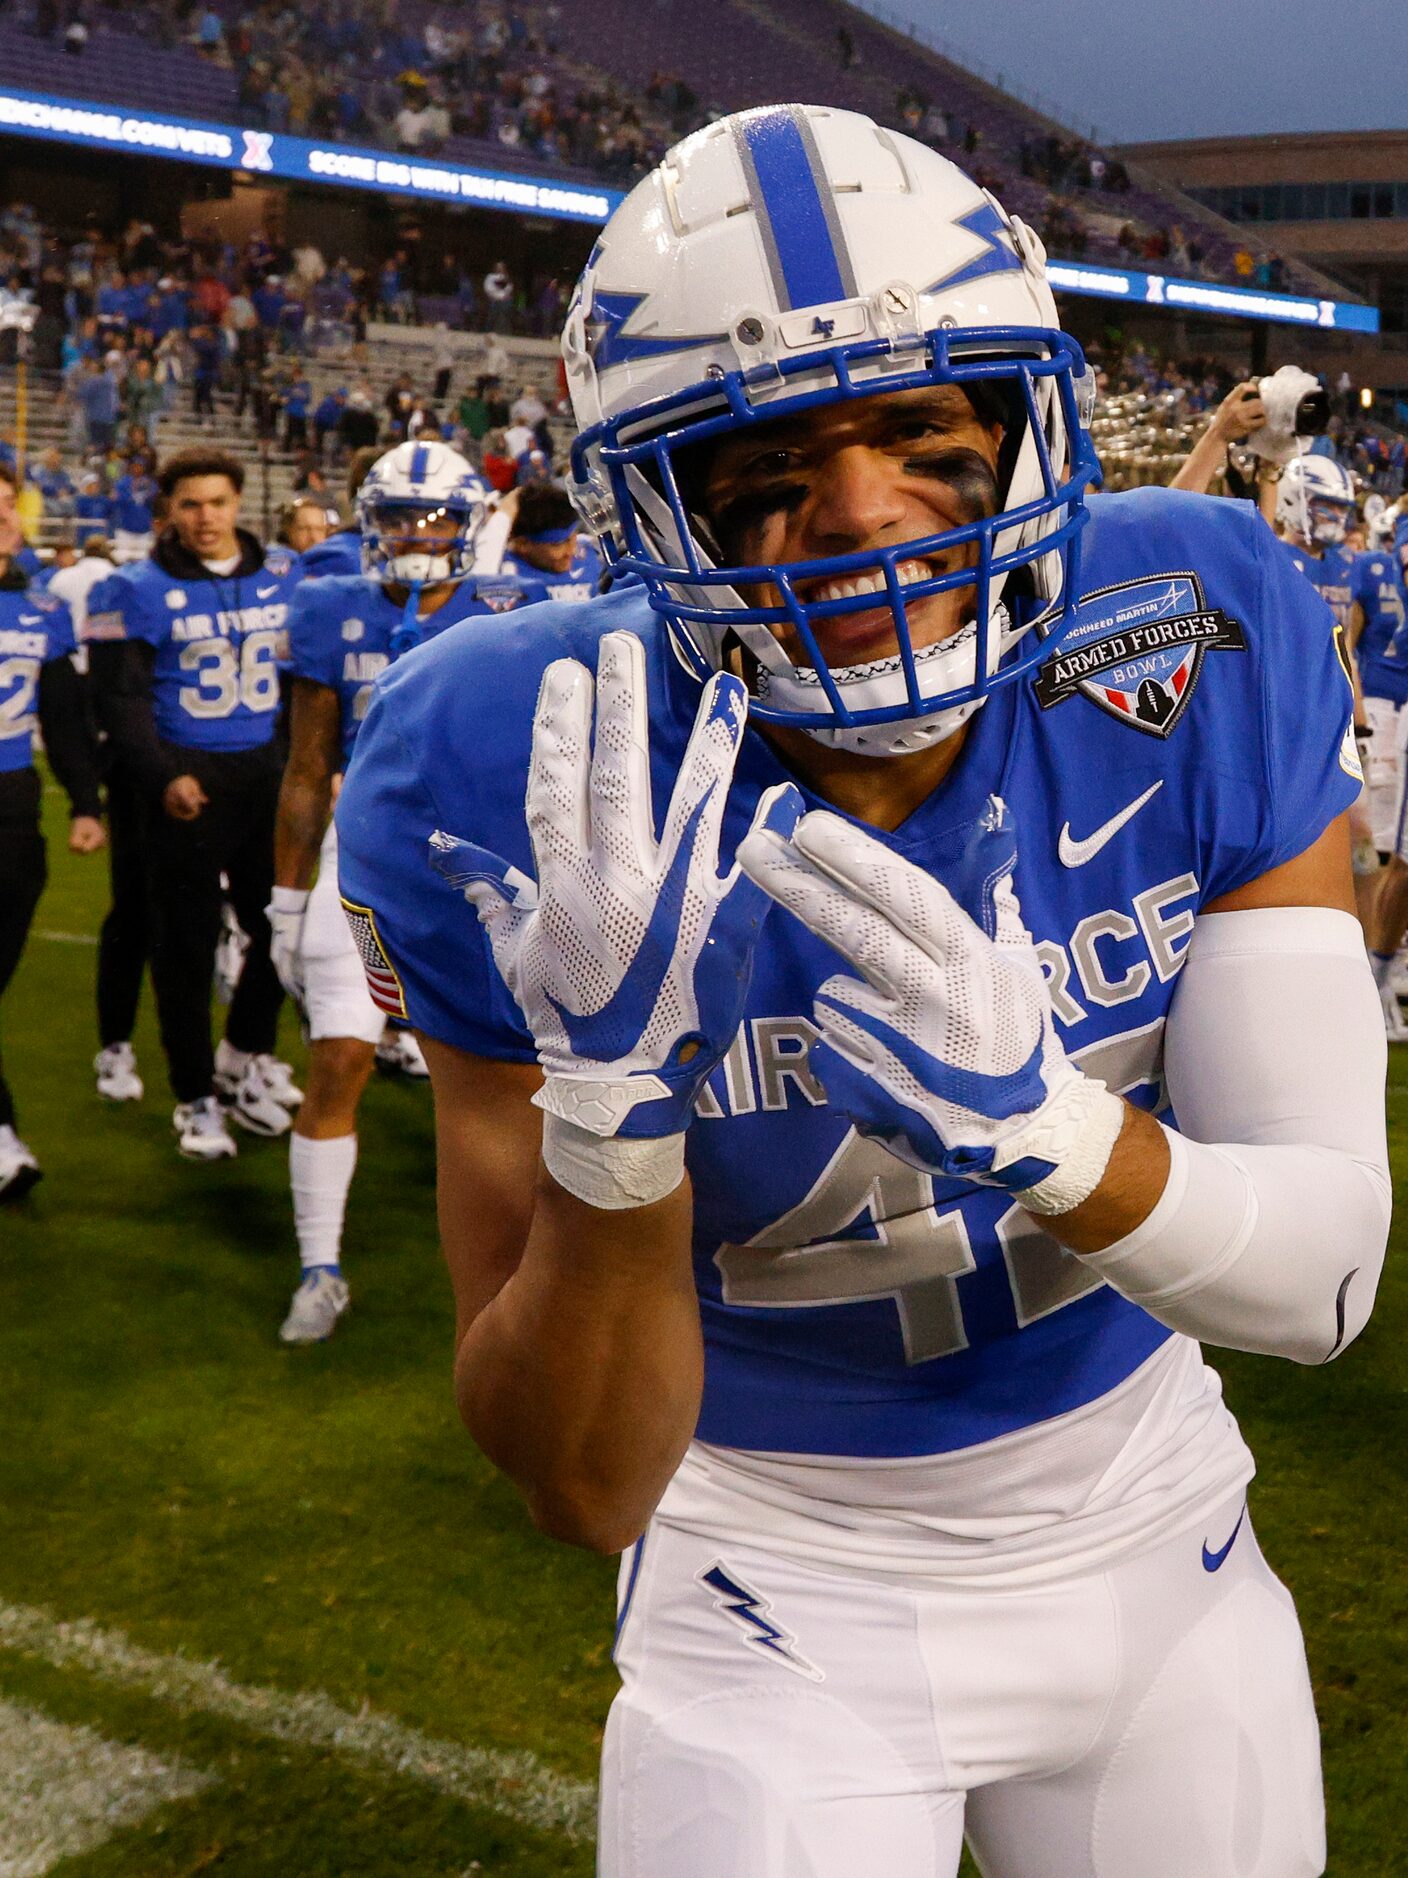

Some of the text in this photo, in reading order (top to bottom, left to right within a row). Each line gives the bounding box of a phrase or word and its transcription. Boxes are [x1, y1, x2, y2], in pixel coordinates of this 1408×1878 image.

[1054, 615, 1219, 684] ARMED FORCES
[1062, 603, 1159, 641] OCKHEED MARTIN
[178, 630, 281, 719] 36
[1112, 653, 1173, 685] BOWL
[1034, 871, 1200, 1028] RCE
